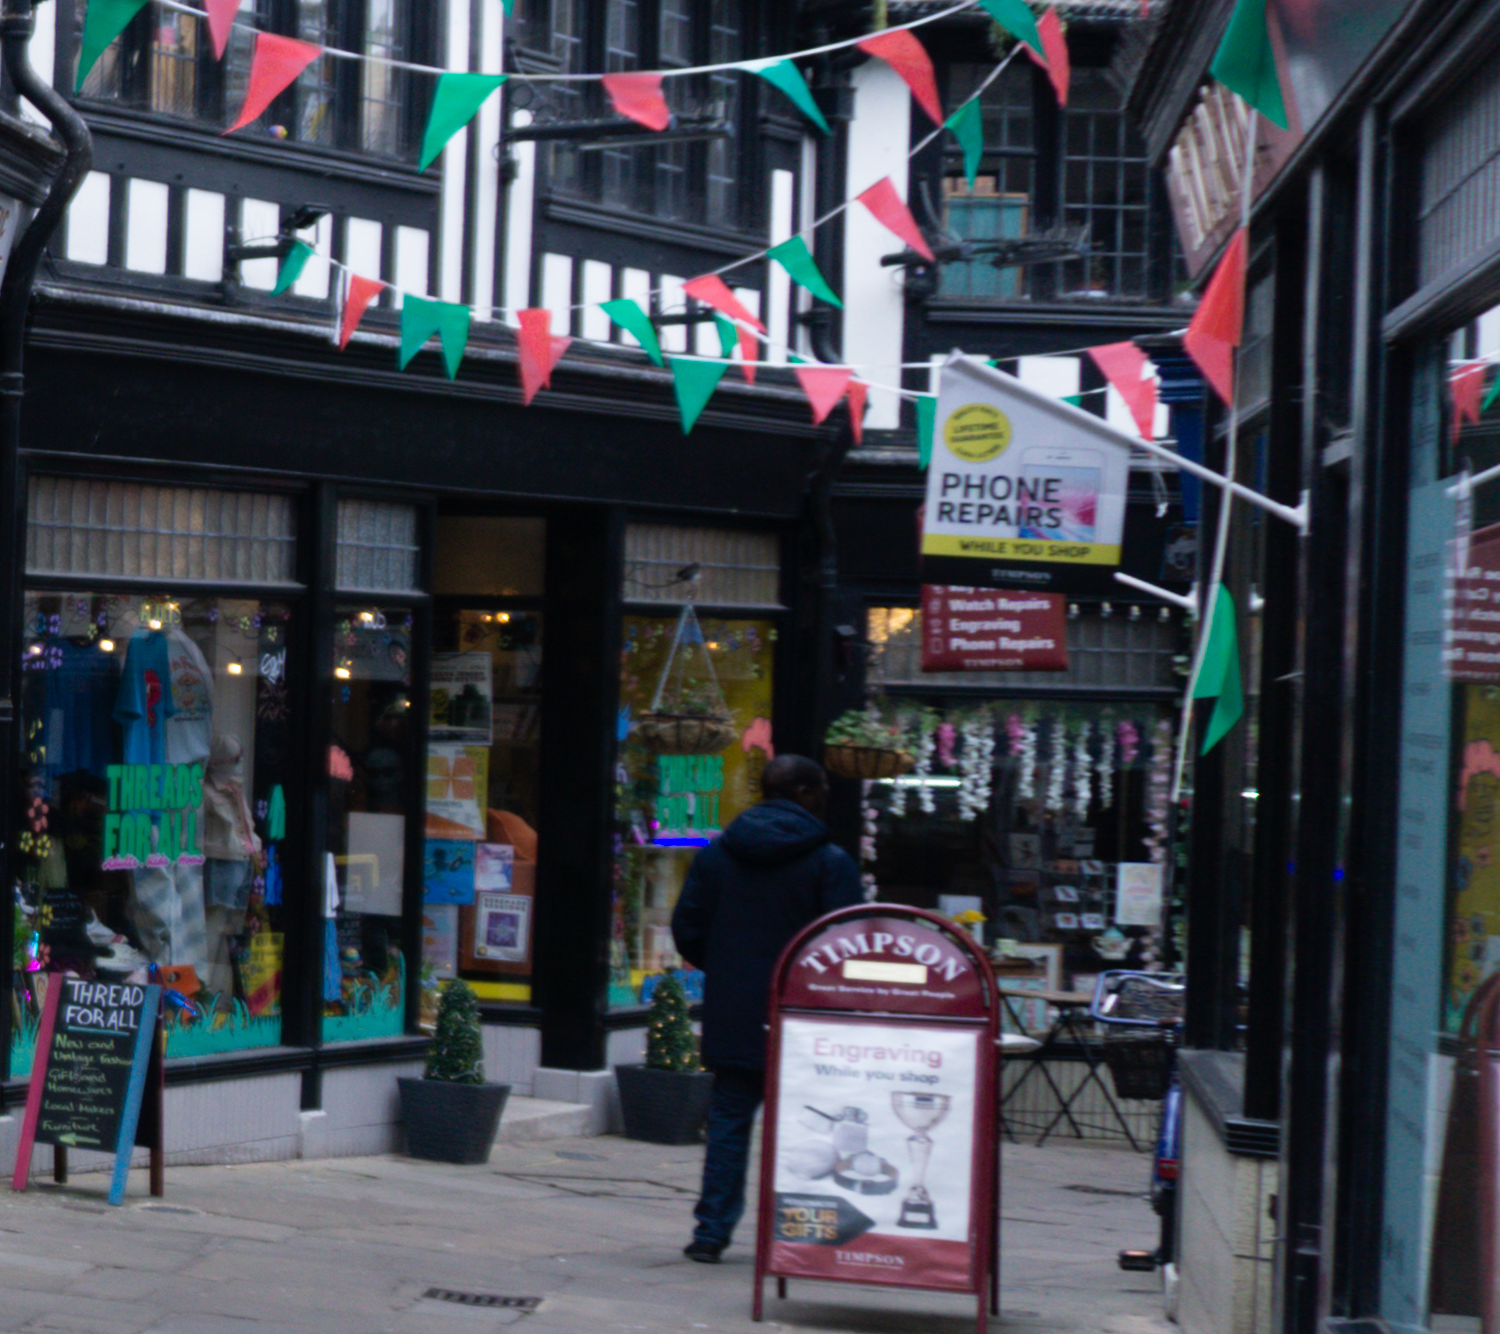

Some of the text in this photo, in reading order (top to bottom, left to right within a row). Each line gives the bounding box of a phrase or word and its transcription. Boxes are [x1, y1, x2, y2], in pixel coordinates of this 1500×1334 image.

[941, 473, 1062, 503] PHONE
[938, 502, 1062, 529] REPAIRS
[960, 539, 1091, 557] WHILE YOU SHOP
[948, 598, 1050, 611] Watch Repairs
[950, 617, 1021, 633] Engraving
[950, 637, 1055, 651] Phone Repairs
[105, 763, 203, 812] THREADS
[102, 809, 200, 861] FOR ALL
[799, 931, 968, 985] TIMPSON
[66, 980, 144, 1007] THREAD
[65, 1005, 138, 1032] FOR ALL
[55, 1033, 115, 1050] New and
[814, 1037, 943, 1068] Engraving
[814, 1064, 940, 1085] While you shop
[44, 1099, 75, 1112] Local
[42, 1120, 100, 1132] Furniture
[783, 1207, 837, 1224] YOUR
[780, 1222, 837, 1240] GIFTS
[835, 1250, 905, 1266] TIMPSON
